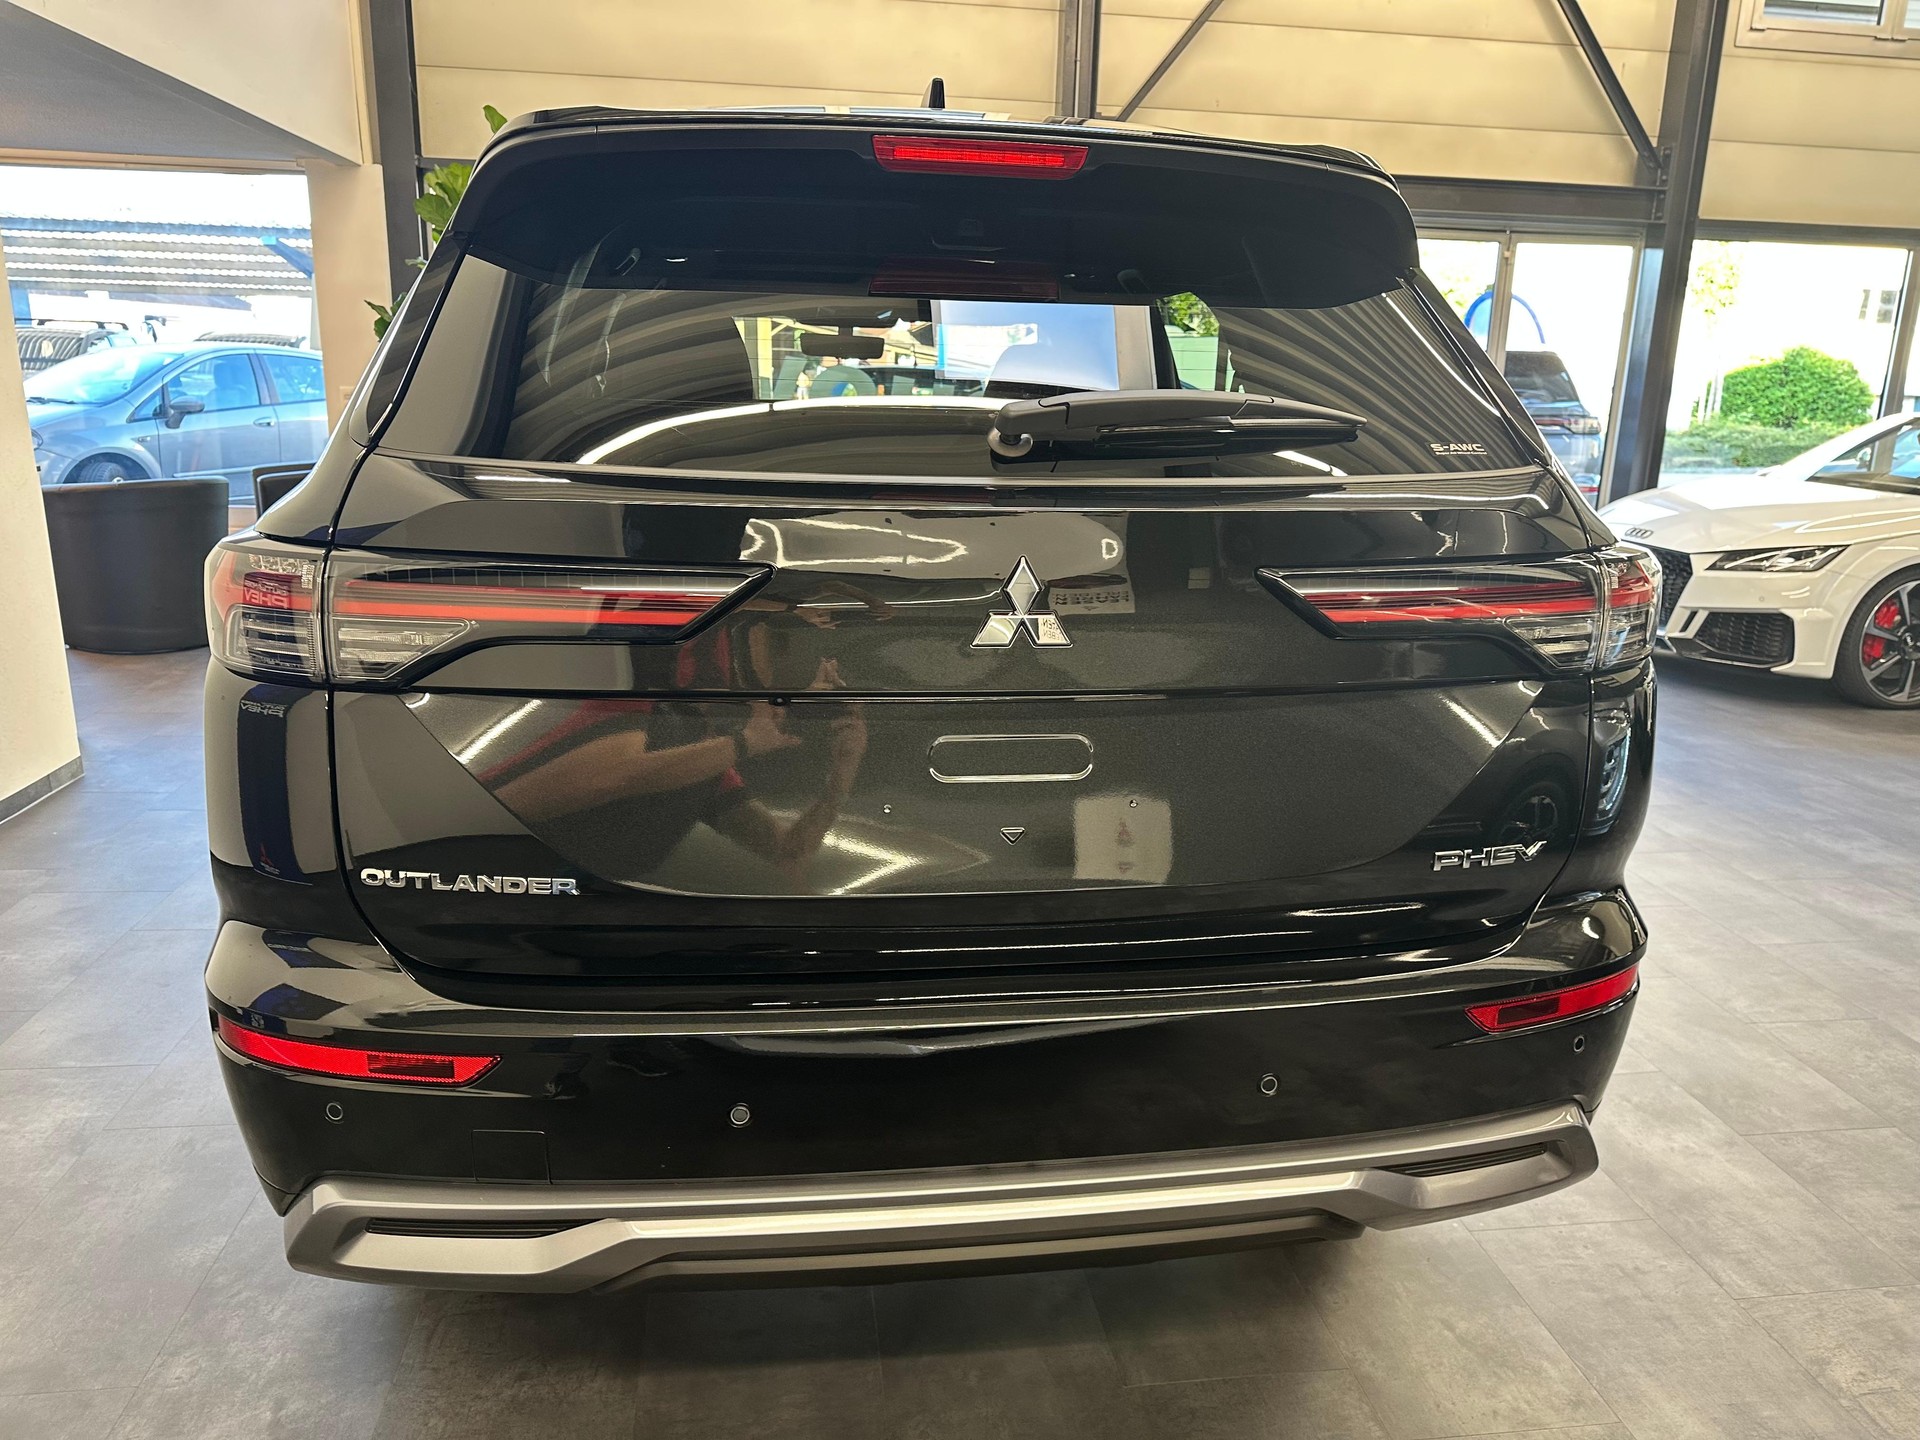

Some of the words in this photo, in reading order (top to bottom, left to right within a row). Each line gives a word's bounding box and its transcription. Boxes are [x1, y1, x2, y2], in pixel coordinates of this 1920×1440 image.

[1430, 443, 1485, 451] S-AWC
[1433, 840, 1547, 871] PHEV
[360, 867, 580, 895] OUTLANDER
